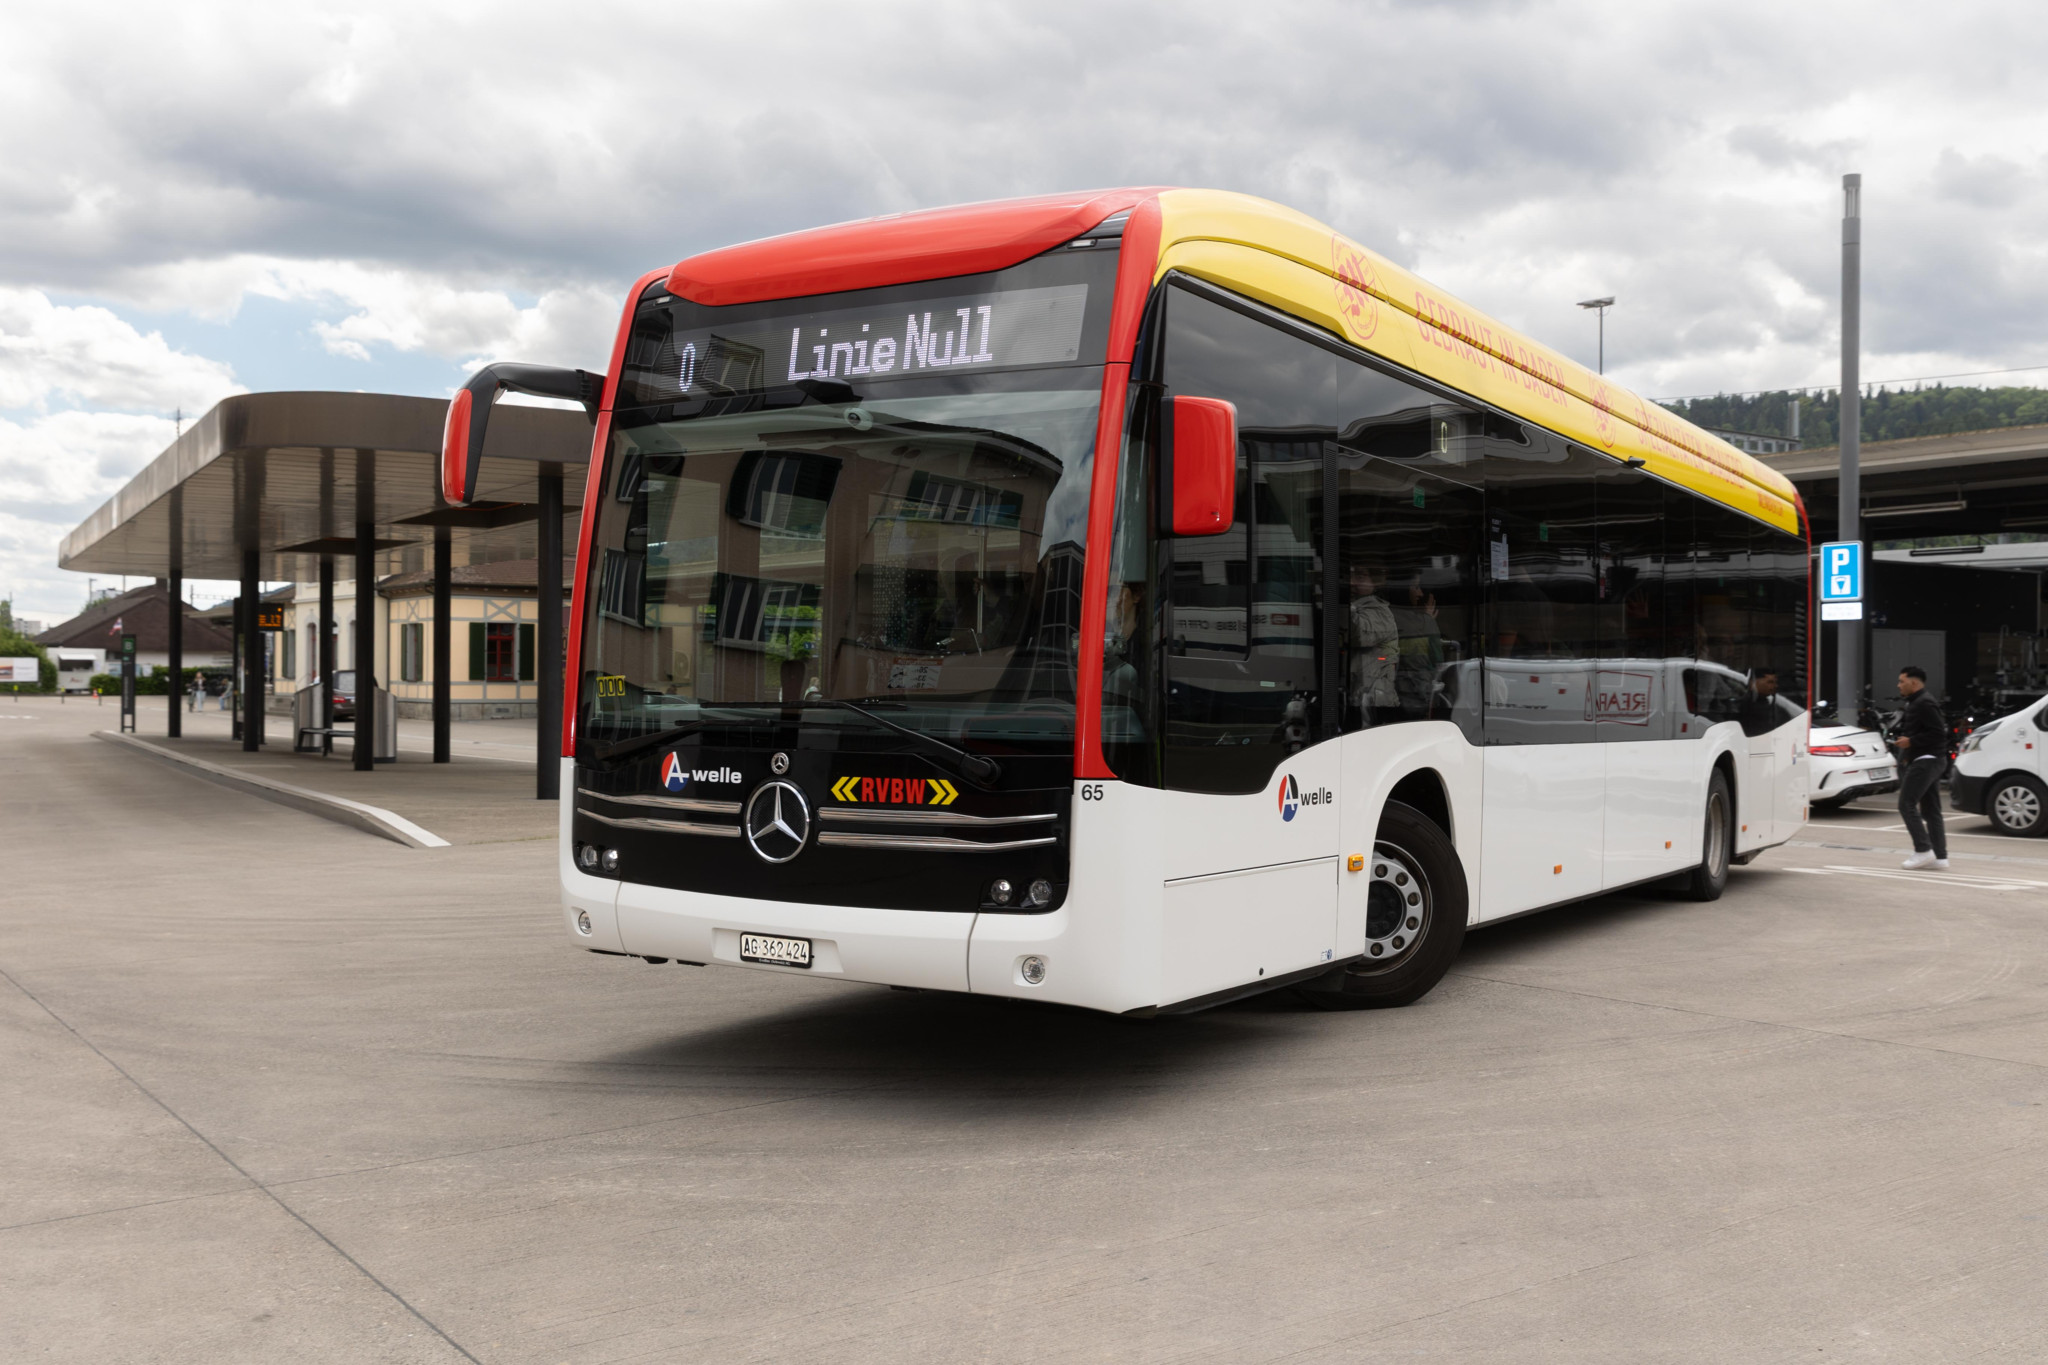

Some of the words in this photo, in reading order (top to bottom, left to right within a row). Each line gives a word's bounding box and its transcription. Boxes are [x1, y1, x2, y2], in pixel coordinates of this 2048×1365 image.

[680, 342, 696, 392] 0
[787, 324, 897, 381] Linie
[902, 305, 993, 370] Null
[1415, 291, 1496, 373] GEBRAUT
[1498, 335, 1518, 384] IN
[1518, 345, 1568, 408] BADEN
[1831, 548, 1850, 575] P
[861, 777, 926, 804] RVBW
[1081, 784, 1104, 801] 65
